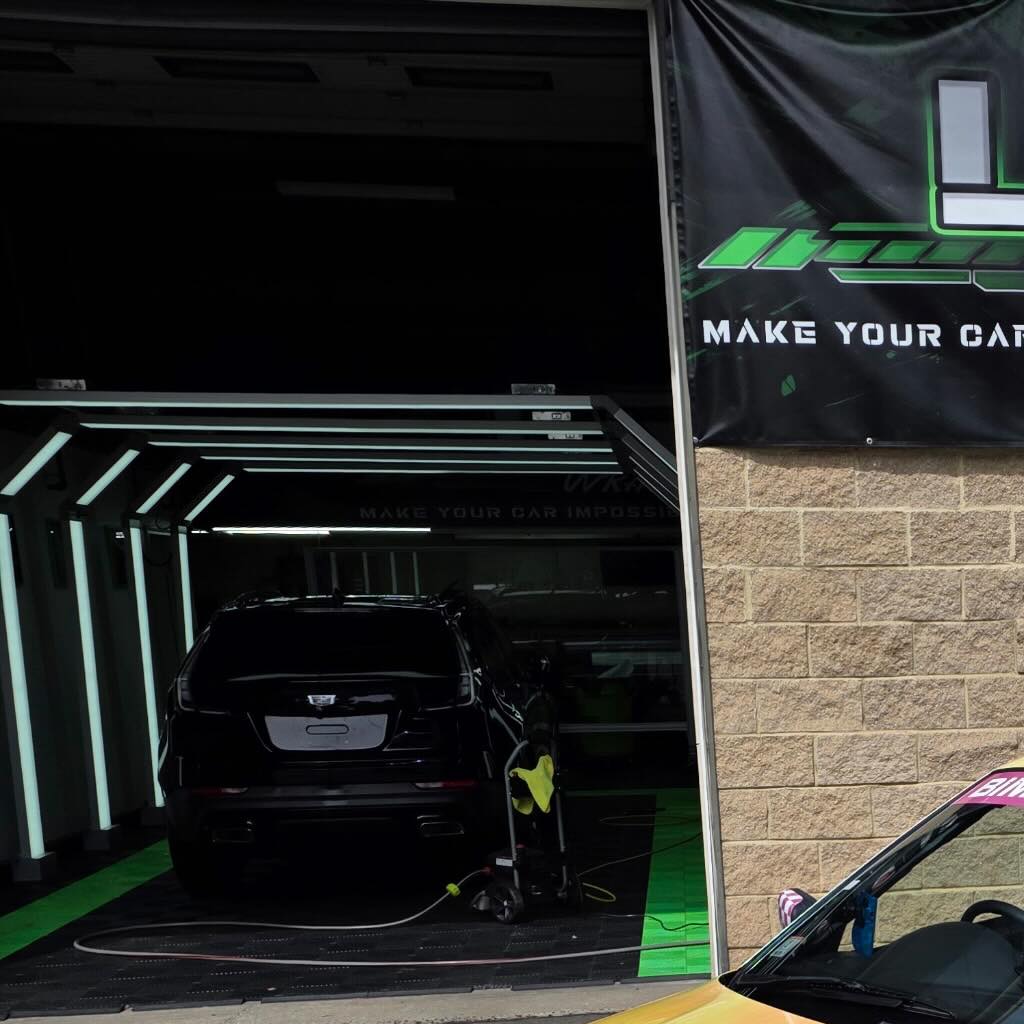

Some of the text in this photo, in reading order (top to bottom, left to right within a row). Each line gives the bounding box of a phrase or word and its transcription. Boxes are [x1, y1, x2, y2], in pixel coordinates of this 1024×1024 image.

[702, 319, 817, 345] MAKE
[837, 321, 942, 347] YOUR
[359, 506, 429, 519] MAKE
[440, 506, 501, 519] YOUR
